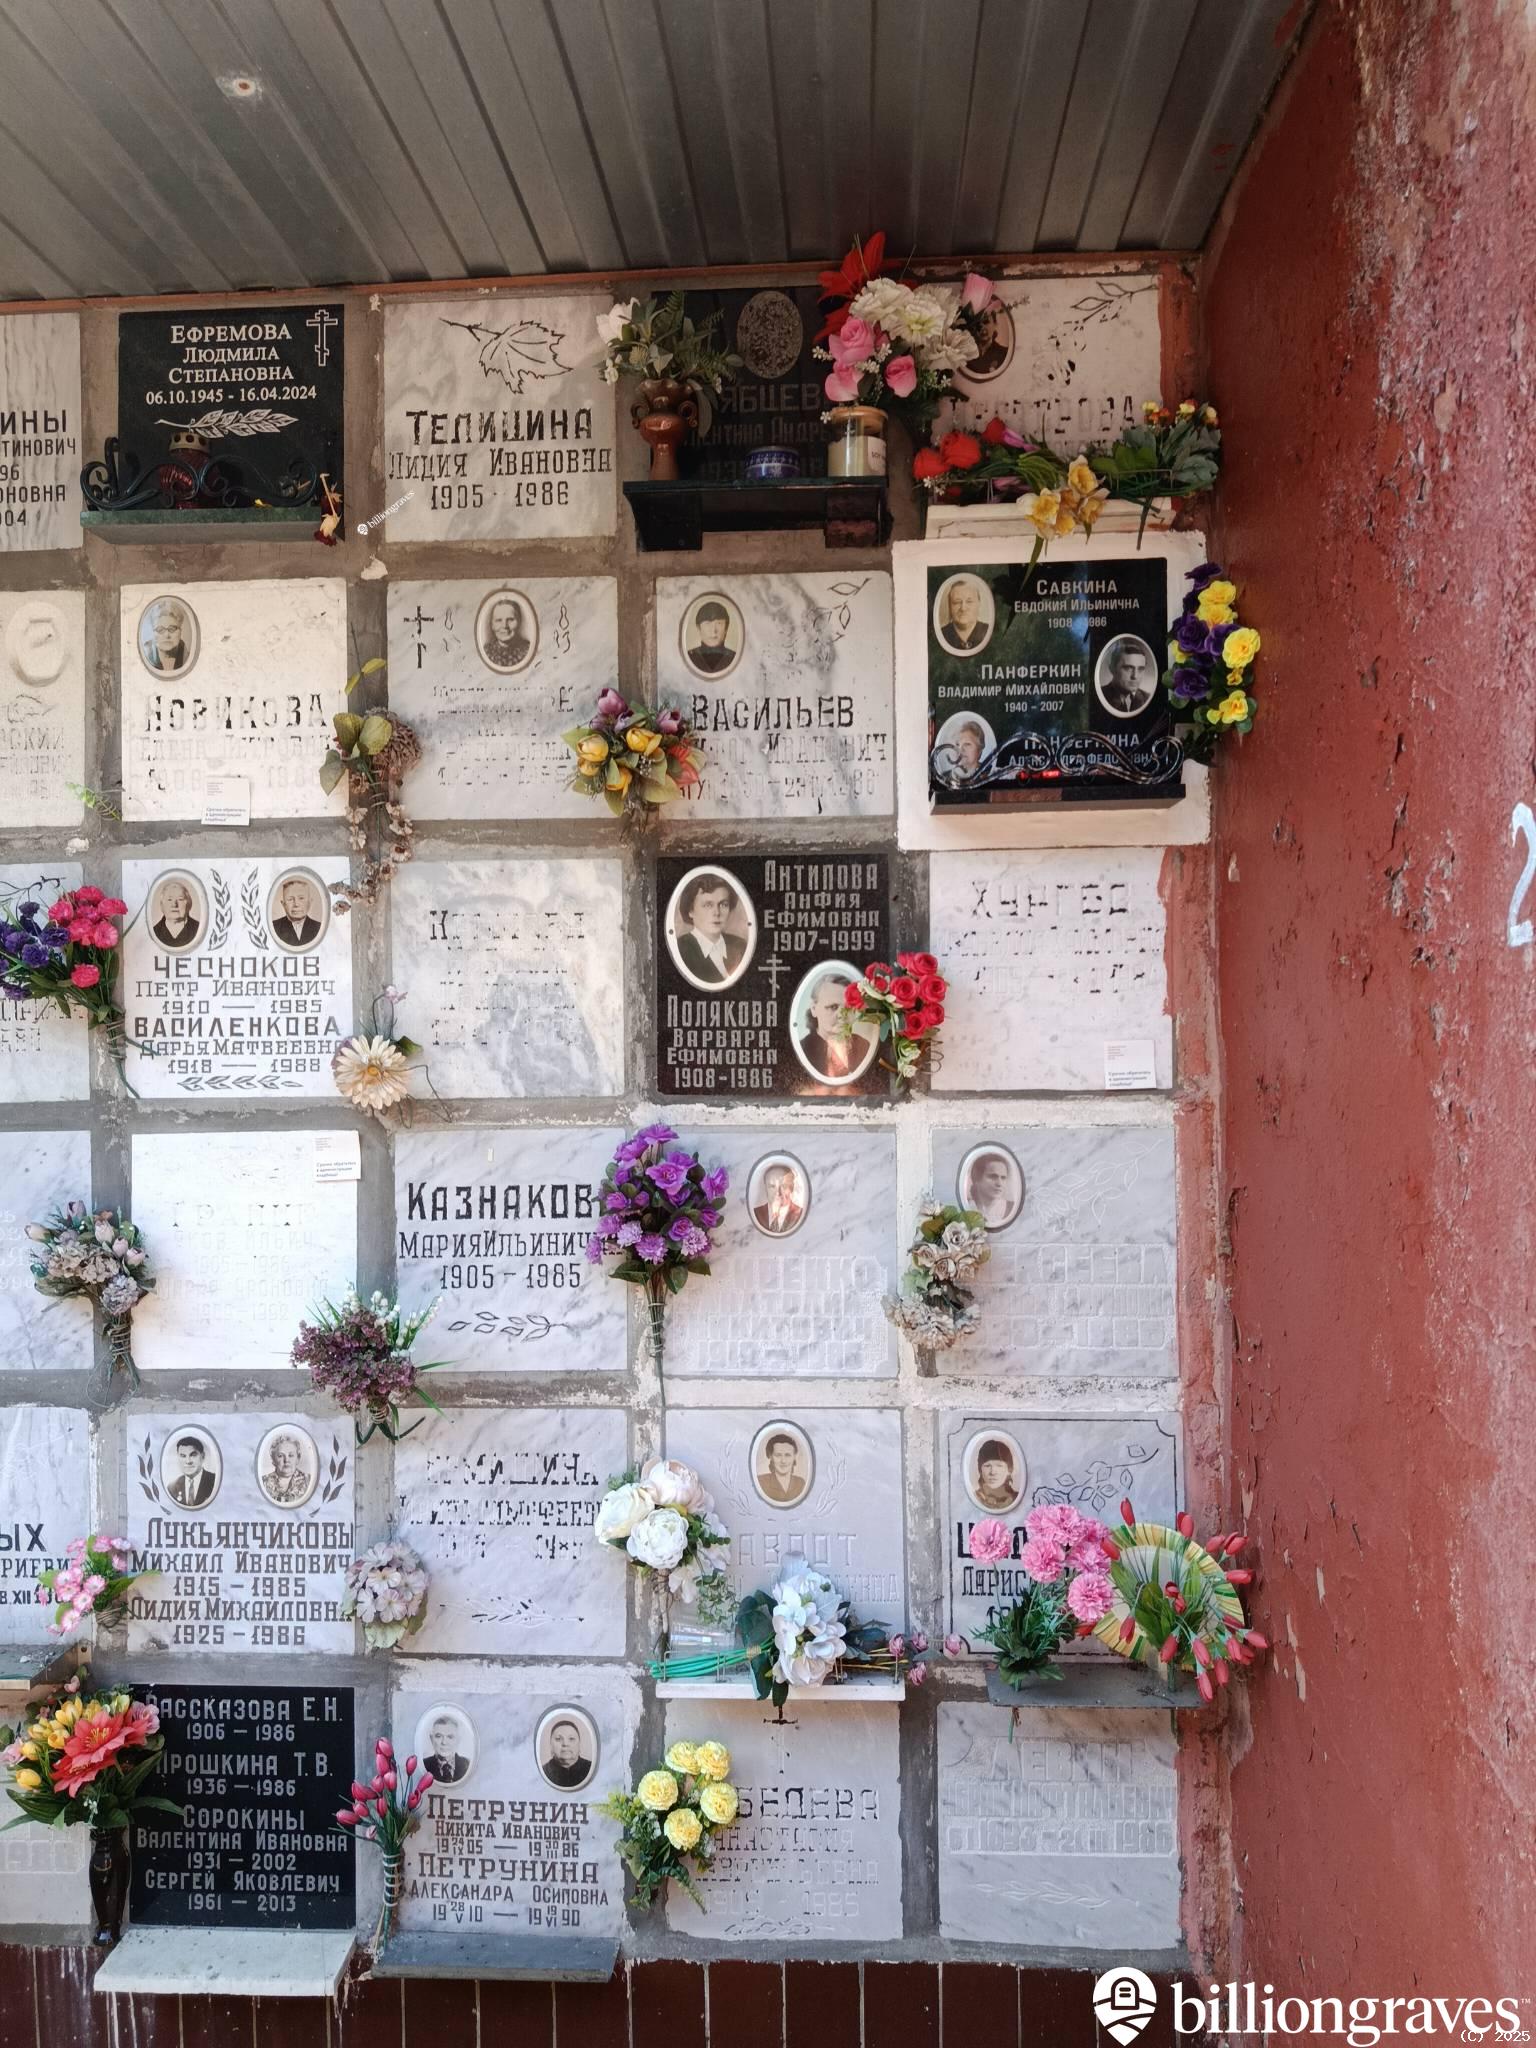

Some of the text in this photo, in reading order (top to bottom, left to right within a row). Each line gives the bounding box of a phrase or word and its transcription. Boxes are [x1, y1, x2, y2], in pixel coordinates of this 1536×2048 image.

[171, 323, 292, 344] ЕФРЕМОВА
[183, 346, 280, 364] ЛЮДМИЛА
[168, 366, 294, 384] СТЕПАНОВНА
[145, 389, 223, 405] 06.10.1945
[239, 386, 317, 403] 16.04.2024
[722, 383, 822, 414] ЯБЦЕВ
[489, 448, 613, 477] ИВАНОВНА
[431, 480, 569, 510] 1905 1986
[0, 509, 26, 526] 04
[1036, 578, 1118, 597] САВКИНА
[1014, 597, 1140, 614] ЕВДОКИЯ ИЛЬИНИЧНА
[1048, 617, 1073, 628] 1908
[981, 663, 1082, 681] ПАНФЕРКИН
[938, 681, 1085, 699] ВЛАДИМИР МИХАЙЛОВИЧ
[145, 693, 329, 733] НОВИКОВА
[692, 694, 854, 732] ВАСИЛЬЕВ
[1004, 702, 1028, 713] 1940
[1040, 701, 1064, 712] 2007
[764, 860, 878, 891] АНТИПОВА
[785, 892, 861, 909] АНФИЯ
[764, 909, 880, 929] ЕФИМОВНА
[154, 955, 320, 979] ЧЕСНОКОВ
[135, 979, 335, 998] ПЕТР ИВАНОВИЧ
[162, 1000, 210, 1015] 1910
[270, 999, 322, 1014] 1985
[667, 995, 778, 1027] ПОЛЯКОВА
[134, 1015, 341, 1038] ВАСИЛЕНКОВА
[673, 1028, 771, 1048] ВАРВАРА
[139, 1039, 210, 1060] ДАРЬЯ
[667, 1047, 778, 1065] ЕФИМОВНА
[167, 1059, 212, 1074] 1918
[271, 1058, 321, 1073] 1988
[407, 1181, 593, 1221] КАЗНАКОВ
[483, 1229, 622, 1257] ИЛЬИНИЧ
[440, 1264, 494, 1289] 1905
[526, 1263, 581, 1288] 1985
[145, 1517, 354, 1550] ЛУКЬЯНЧИКОВЫ
[0, 1558, 77, 1578] РИЕВИ
[131, 1551, 351, 1574] МИХАИЛ ИВАНОВИЧ
[173, 1576, 220, 1597] 1915
[251, 1576, 306, 1597] 1985
[962, 1566, 1038, 1596] ЛАРИС
[129, 1596, 201, 1622] ЛИДИЯ
[173, 1625, 224, 1645] 1925
[251, 1625, 305, 1645] 1986
[187, 1723, 225, 1740] 1906
[255, 1724, 295, 1741] 1986
[187, 1778, 227, 1795] 1936
[256, 1780, 296, 1796] 1986
[427, 1794, 590, 1825] ПЕТРУНИН
[736, 1787, 879, 1820] БЕДЕВА
[183, 1804, 305, 1831] СОРОКИНЫ
[137, 1828, 348, 1852] ВАЛЕНТИНА ИВАНОВНА
[434, 1821, 581, 1841] НИКИТА ИВАНОВИЧ
[187, 1852, 221, 1870] 1931
[251, 1853, 297, 1871] 2002
[418, 1853, 599, 1884] ПЕТРУНИНА
[145, 1869, 340, 1893] СЕРГЕЙ ЯКОВЛЕВИЧ
[188, 1894, 222, 1911] 1961
[257, 1894, 297, 1912] 2013
[410, 1880, 609, 1906] АЛЕКСАНДРА ОСИПОВНА
